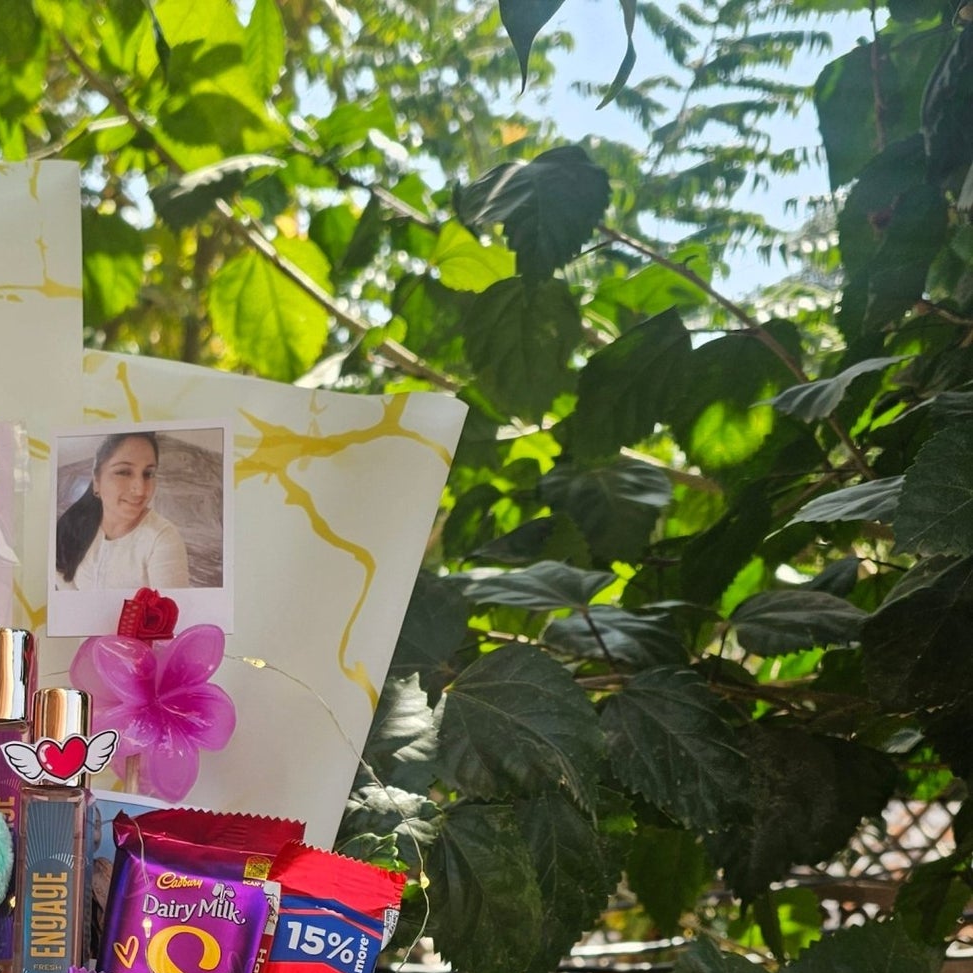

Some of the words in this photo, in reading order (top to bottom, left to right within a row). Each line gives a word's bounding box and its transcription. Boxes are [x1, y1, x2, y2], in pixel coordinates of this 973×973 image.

[156, 871, 204, 890] Cadbury
[142, 893, 197, 922] Dairy
[197, 897, 246, 925] Milk
[287, 921, 355, 964] 15%
[32, 963, 63, 971] FRESH
